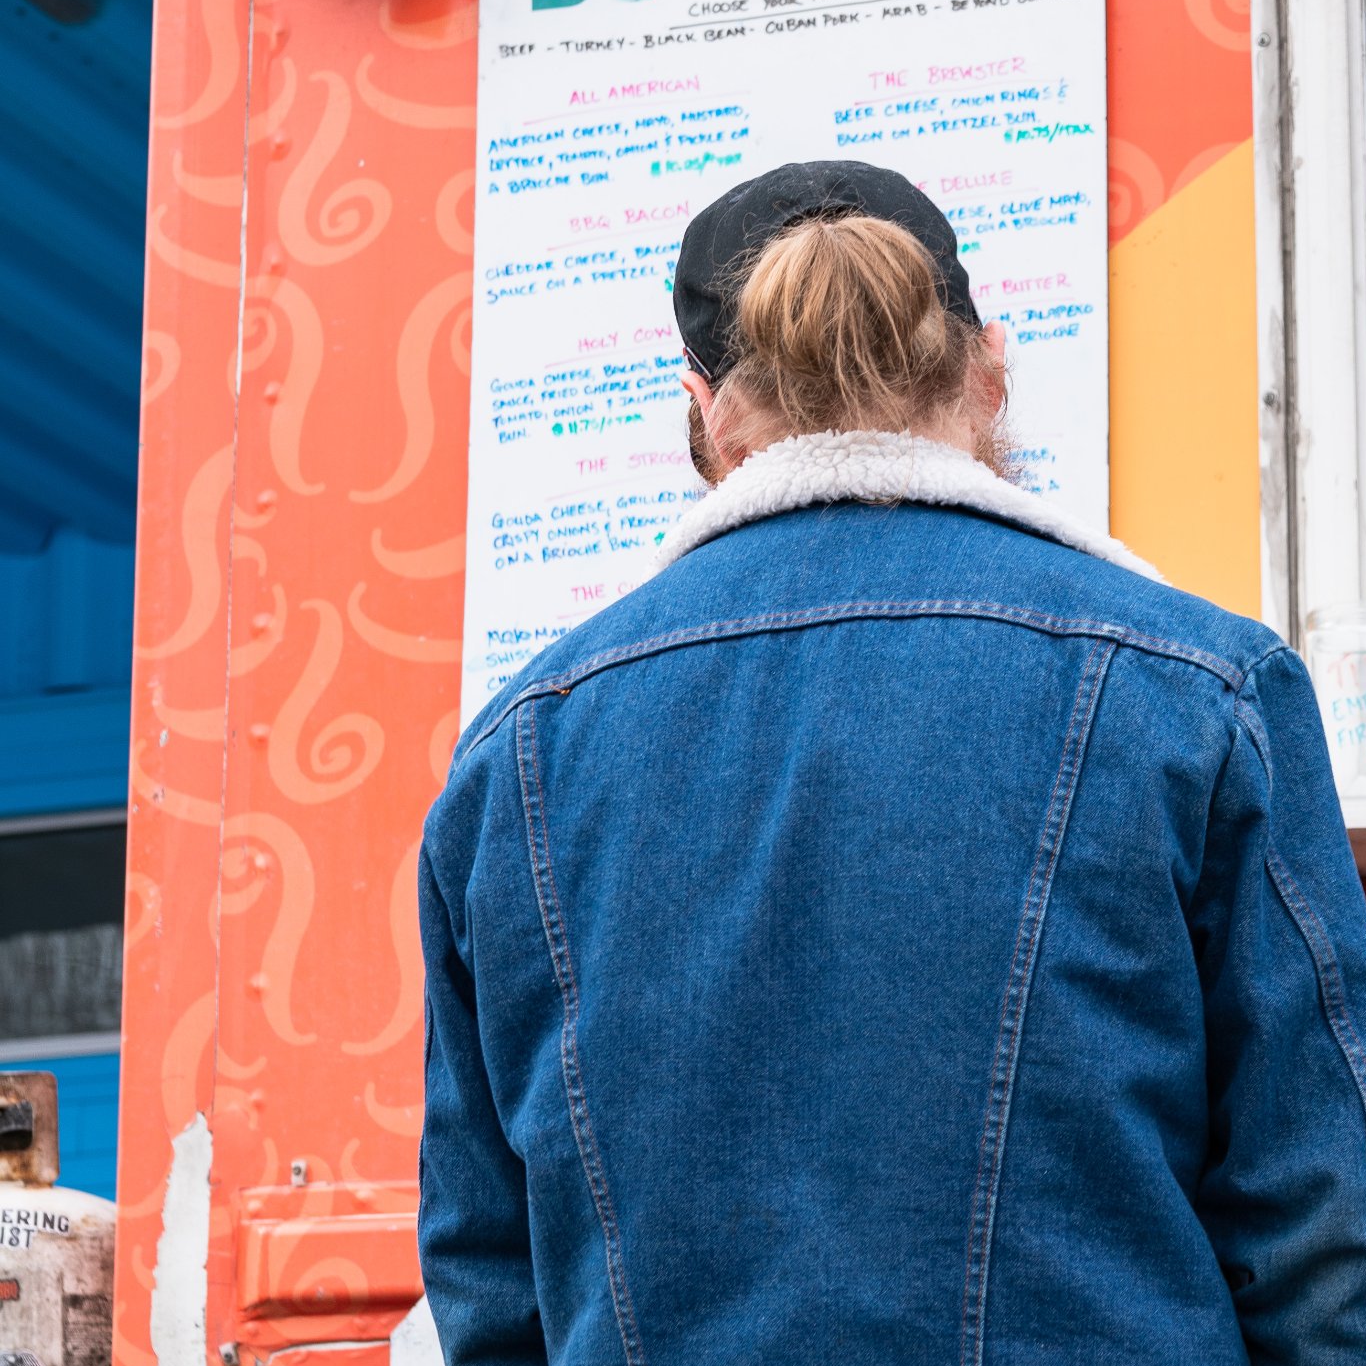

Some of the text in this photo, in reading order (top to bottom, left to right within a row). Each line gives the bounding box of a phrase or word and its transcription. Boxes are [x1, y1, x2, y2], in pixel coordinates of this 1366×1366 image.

[688, 0, 749, 17] CHOOSE
[499, 43, 536, 58] BEEF
[560, 37, 625, 54] TURKEY
[643, 33, 696, 49] BLACK
[704, 26, 746, 43] BEAN
[765, 16, 817, 35] CUBAN
[823, 12, 860, 27] PORK
[882, 3, 927, 19] KRAB
[868, 56, 1026, 92] THE BREWSTER
[569, 75, 701, 106] ALL AMERICAN
[834, 106, 875, 125] BEER
[951, 92, 995, 109] ONION
[1000, 85, 1049, 103] RINGS
[836, 130, 884, 147] BACON
[892, 128, 910, 139] ON
[918, 125, 926, 135] A
[931, 115, 1001, 133] PRETZEL
[941, 170, 1013, 194] DELUXE
[569, 200, 690, 232] BBQ BACON
[1001, 196, 1044, 215] OLIVE
[976, 223, 994, 234] ON
[999, 221, 1007, 230] A
[1012, 212, 1078, 229] BRIOCHE
[485, 260, 554, 281] CHEDDAR
[487, 282, 536, 304] SAUCE
[546, 279, 565, 291] ON
[573, 276, 583, 285] A
[591, 266, 659, 282] PRETZEL
[1002, 272, 1072, 295] BUTTER
[577, 324, 673, 352] HOLY COW
[490, 378, 536, 393] GOUDA
[541, 387, 578, 403] FRIED
[584, 379, 633, 395] CHEESE
[553, 403, 595, 418] ONION
[576, 457, 609, 476] THE
[492, 512, 543, 529] GOUDA
[616, 491, 677, 509] GRILLED
[494, 530, 539, 550] CRISPY
[547, 522, 597, 540] ONIONS
[620, 514, 670, 530] FRENCH
[542, 542, 601, 563] BRIOCHE
[571, 583, 605, 602] THE
